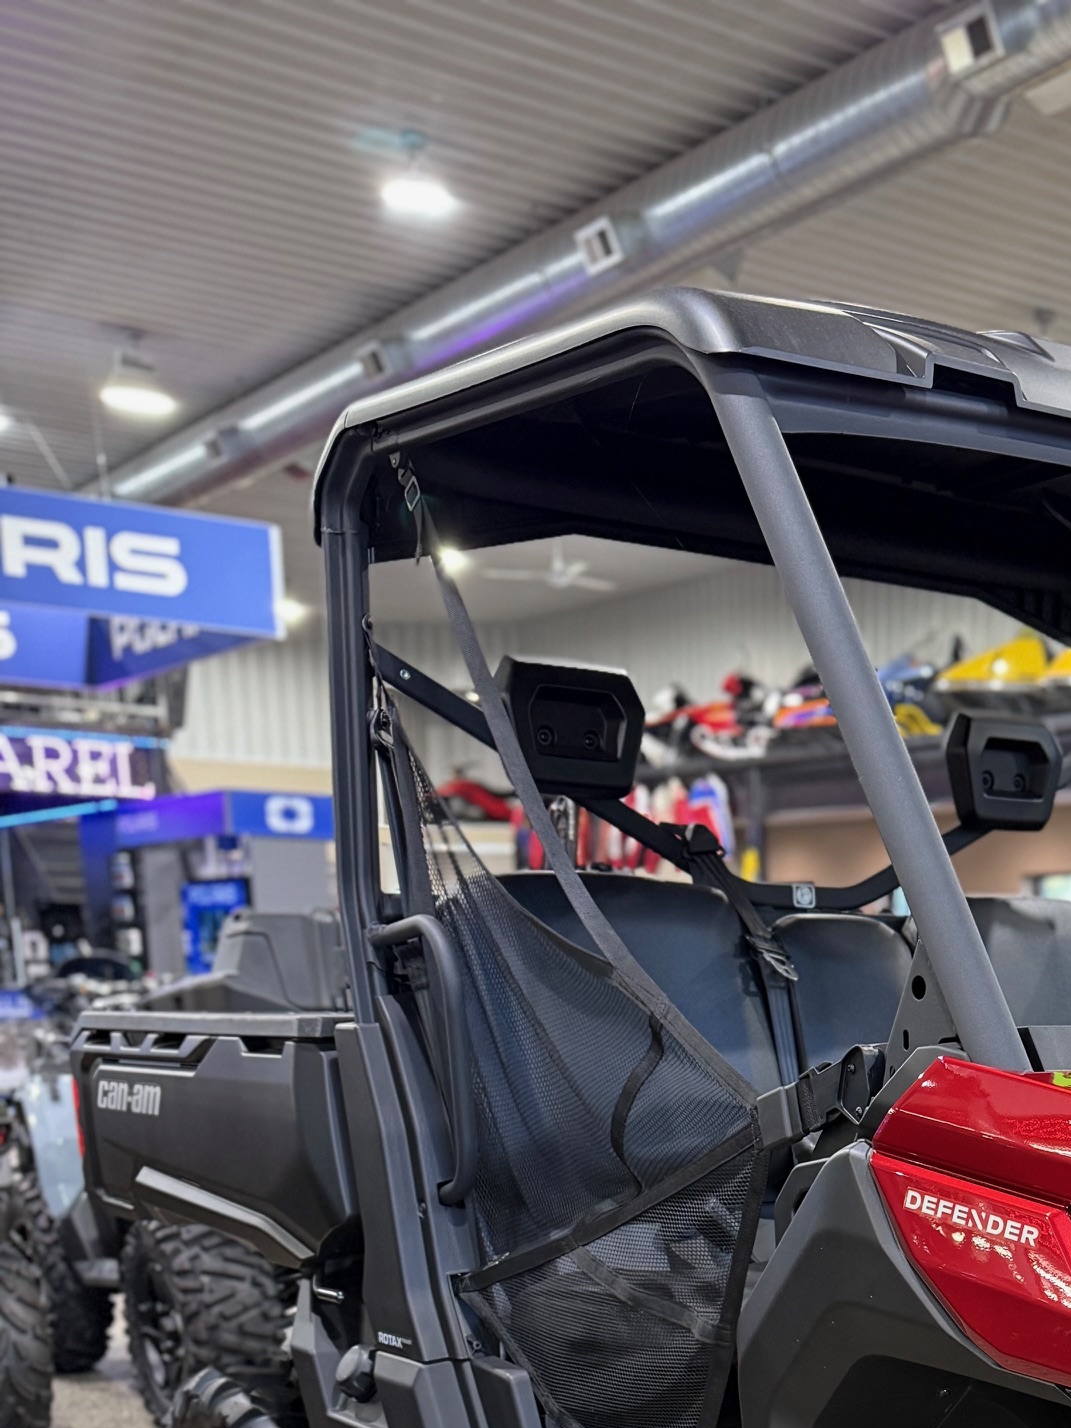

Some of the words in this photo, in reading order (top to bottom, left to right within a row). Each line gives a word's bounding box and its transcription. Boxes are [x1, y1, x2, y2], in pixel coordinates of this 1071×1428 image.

[0, 513, 188, 597] RIS
[904, 1189, 1040, 1247] DEFENDER
[377, 1331, 403, 1349] ROTAX
